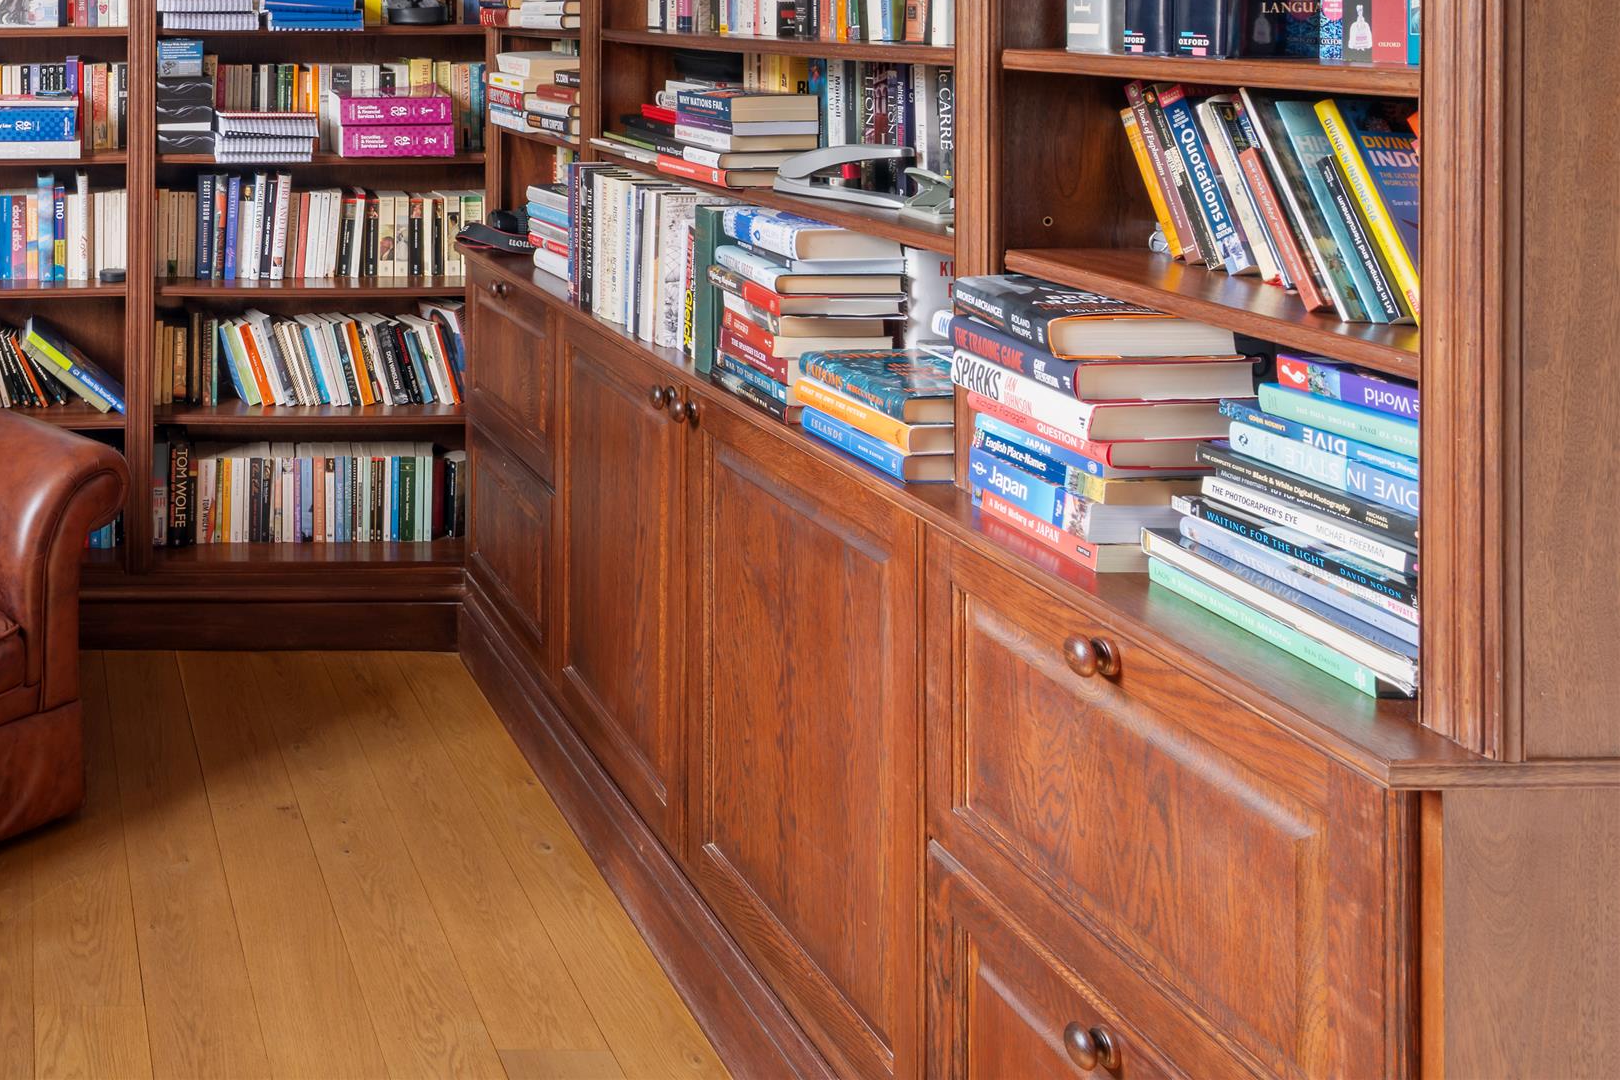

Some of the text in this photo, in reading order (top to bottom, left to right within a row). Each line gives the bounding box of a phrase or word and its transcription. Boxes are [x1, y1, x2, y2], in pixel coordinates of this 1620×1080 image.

[1179, 37, 1210, 47] OXFORD
[679, 95, 724, 110] WHY NATIONS FAIL
[1361, 136, 1414, 150] DIVIN
[1181, 130, 1224, 222] Quotations
[1324, 118, 1379, 223] DIVING IN INDONESIA
[1337, 194, 1383, 292] Pompeii Herculaneum
[956, 289, 1004, 318] BROKEN ARCHANGEL
[1011, 314, 1031, 329] ROLAND
[954, 326, 1025, 374] THE TRADING GAME
[954, 356, 1001, 401] SPARKS
[1004, 376, 1018, 393] IAN
[1003, 390, 1034, 415] JOHNSON
[1364, 386, 1412, 414] World
[811, 418, 842, 441] ISLANDS
[1036, 423, 1085, 450] QUESTION 7
[1302, 427, 1347, 455] DIVE
[985, 436, 1047, 472] English Place-Names
[1024, 437, 1052, 455] JAPAN
[175, 448, 188, 528] TOM WOLFE
[988, 465, 1028, 501] Japan
[1347, 467, 1367, 488] IN
[1211, 484, 1298, 525] THE PHOTOGRAPHER'S EYE
[1252, 471, 1351, 513] Black White Digital Photography
[994, 500, 1007, 514] Brief
[1008, 507, 1028, 527] History
[1035, 521, 1060, 544] JAPAN
[1365, 516, 1389, 529] FREEMAN
[1367, 510, 1388, 523] MICHAEL
[1206, 511, 1325, 568] WAITING FOR THE LIGHT
[1316, 524, 1385, 559] MICHAEL FREEMAN
[1339, 567, 1402, 599] DAVID NOTON
[1387, 600, 1414, 619] PRIVATE
